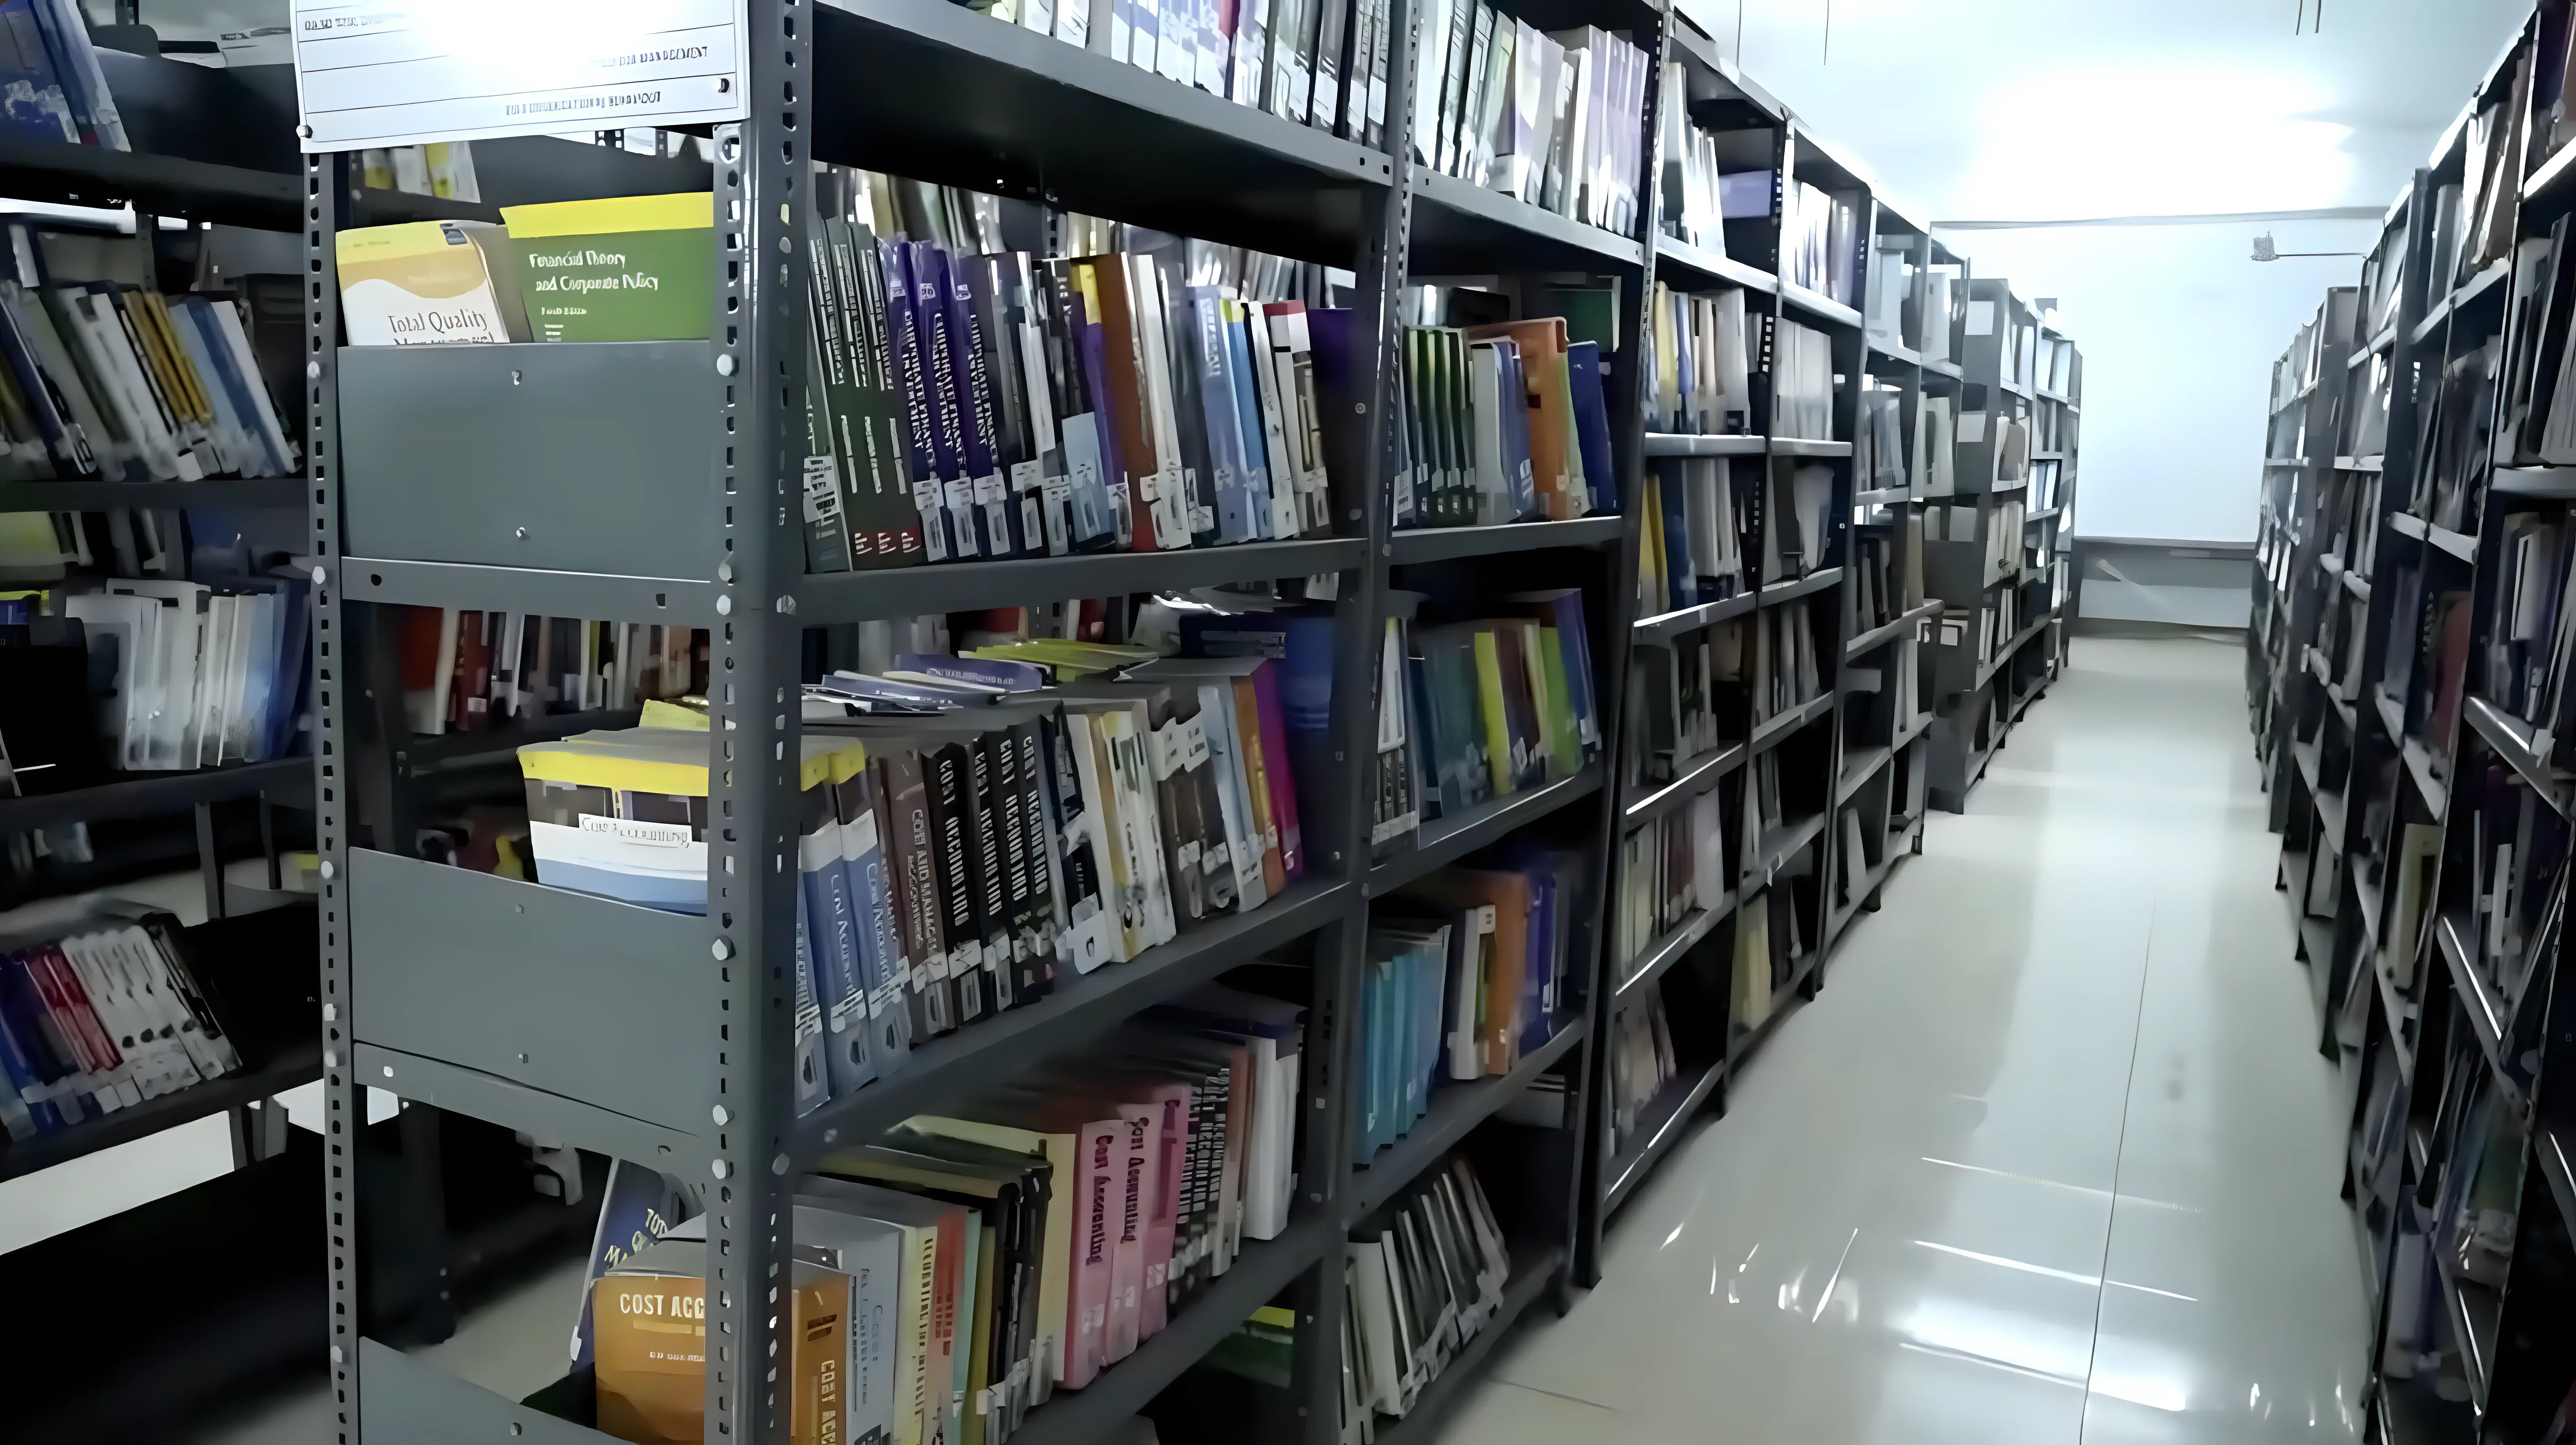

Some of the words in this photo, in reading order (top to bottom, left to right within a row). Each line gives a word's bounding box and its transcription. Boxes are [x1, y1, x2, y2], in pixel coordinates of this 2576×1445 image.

[388, 313, 425, 333] Total
[428, 308, 487, 334] Quality
[620, 1293, 664, 1315] COST
